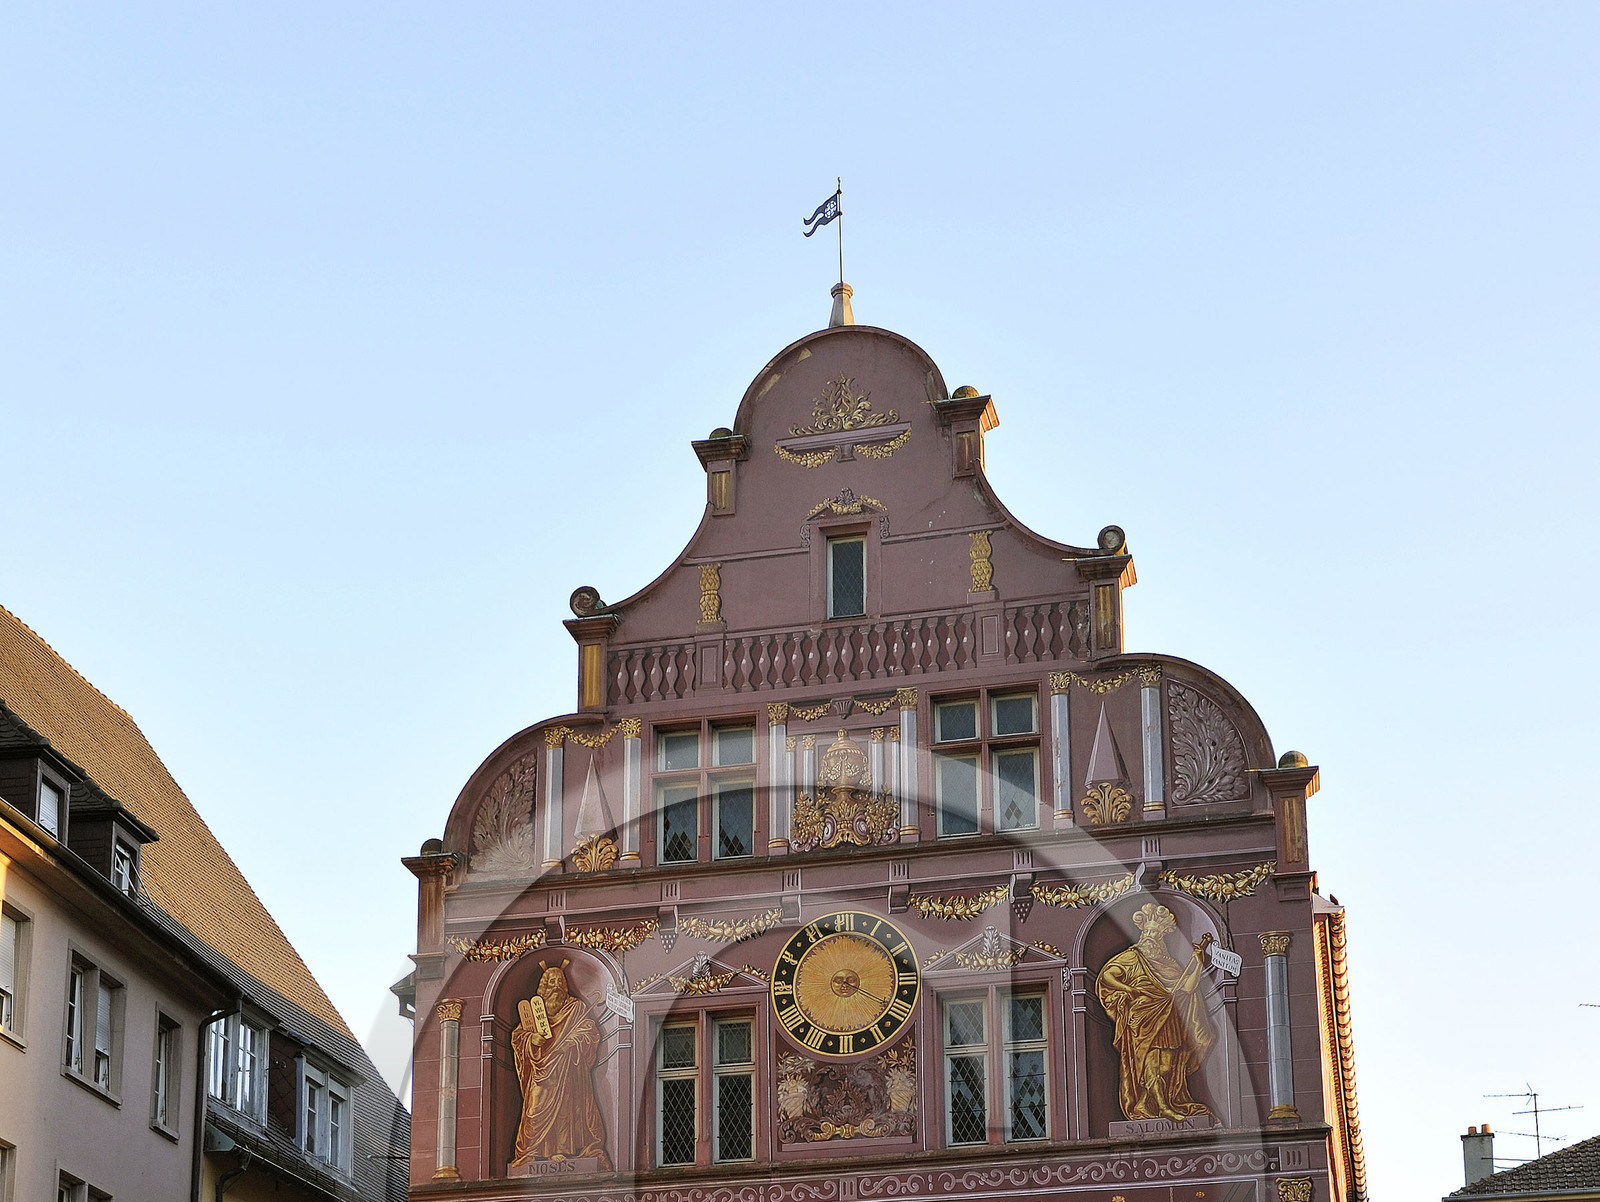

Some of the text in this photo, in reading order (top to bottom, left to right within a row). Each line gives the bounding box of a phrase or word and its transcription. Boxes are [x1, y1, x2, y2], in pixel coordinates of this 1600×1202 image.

[834, 914, 855, 932] XII
[870, 920, 882, 936] I
[805, 923, 823, 942] XI
[890, 941, 908, 957] II
[782, 951, 798, 966] X
[899, 972, 917, 986] III
[774, 980, 793, 996] IX
[888, 998, 912, 1022] IIII
[1125, 1118, 1195, 1135] SALOMON
[528, 1161, 576, 1175] MOSES
